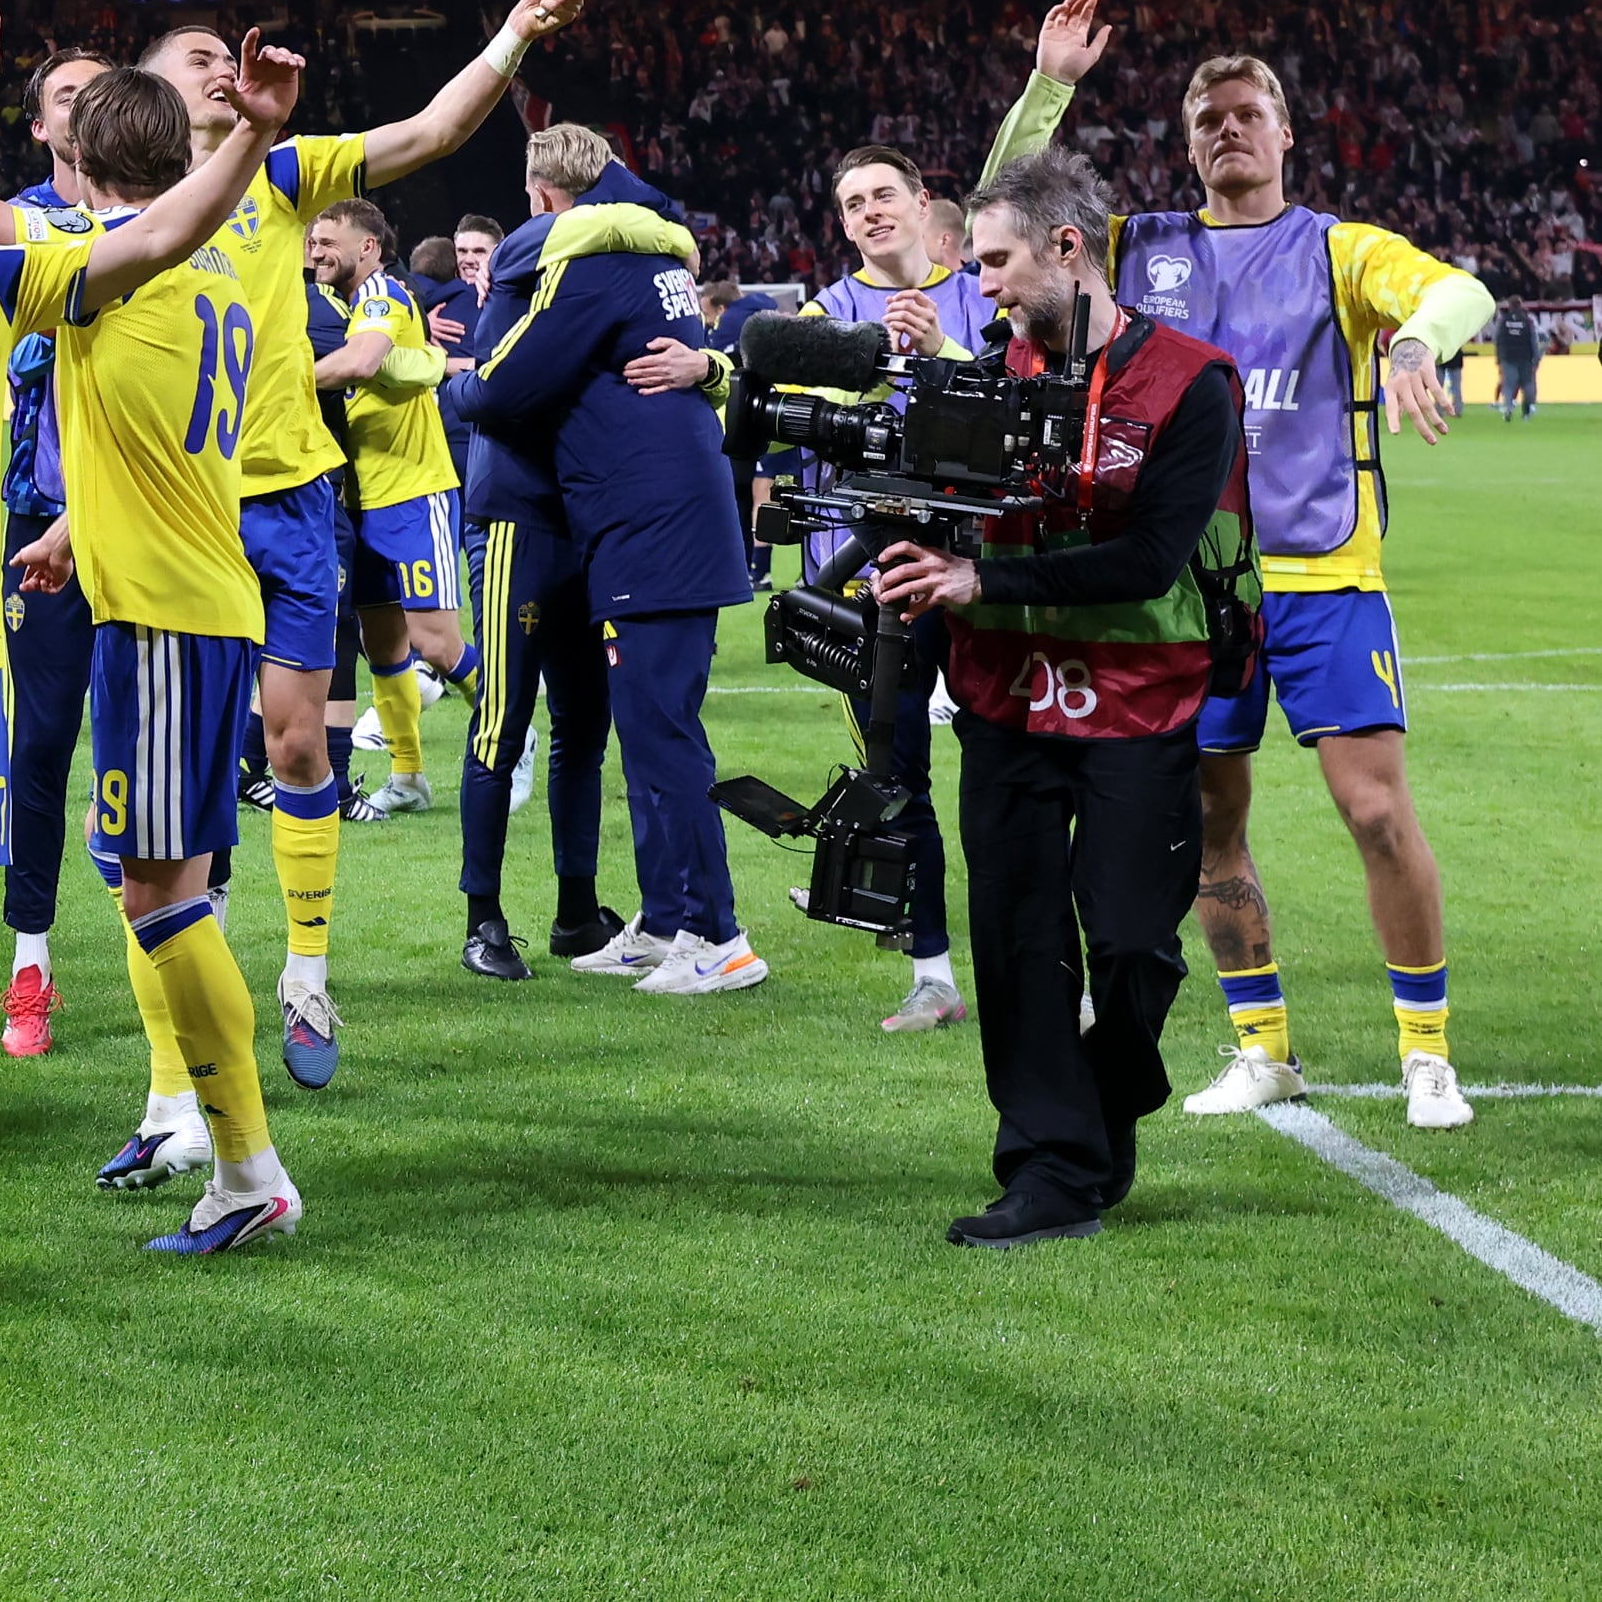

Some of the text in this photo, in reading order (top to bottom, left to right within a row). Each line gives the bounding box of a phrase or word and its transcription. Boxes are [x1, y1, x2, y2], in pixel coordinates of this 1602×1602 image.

[185, 294, 254, 460] 19
[399, 559, 434, 599] 16
[1370, 650, 1400, 710] 4
[94, 769, 129, 837] 9
[188, 1063, 219, 1079] RIGE
